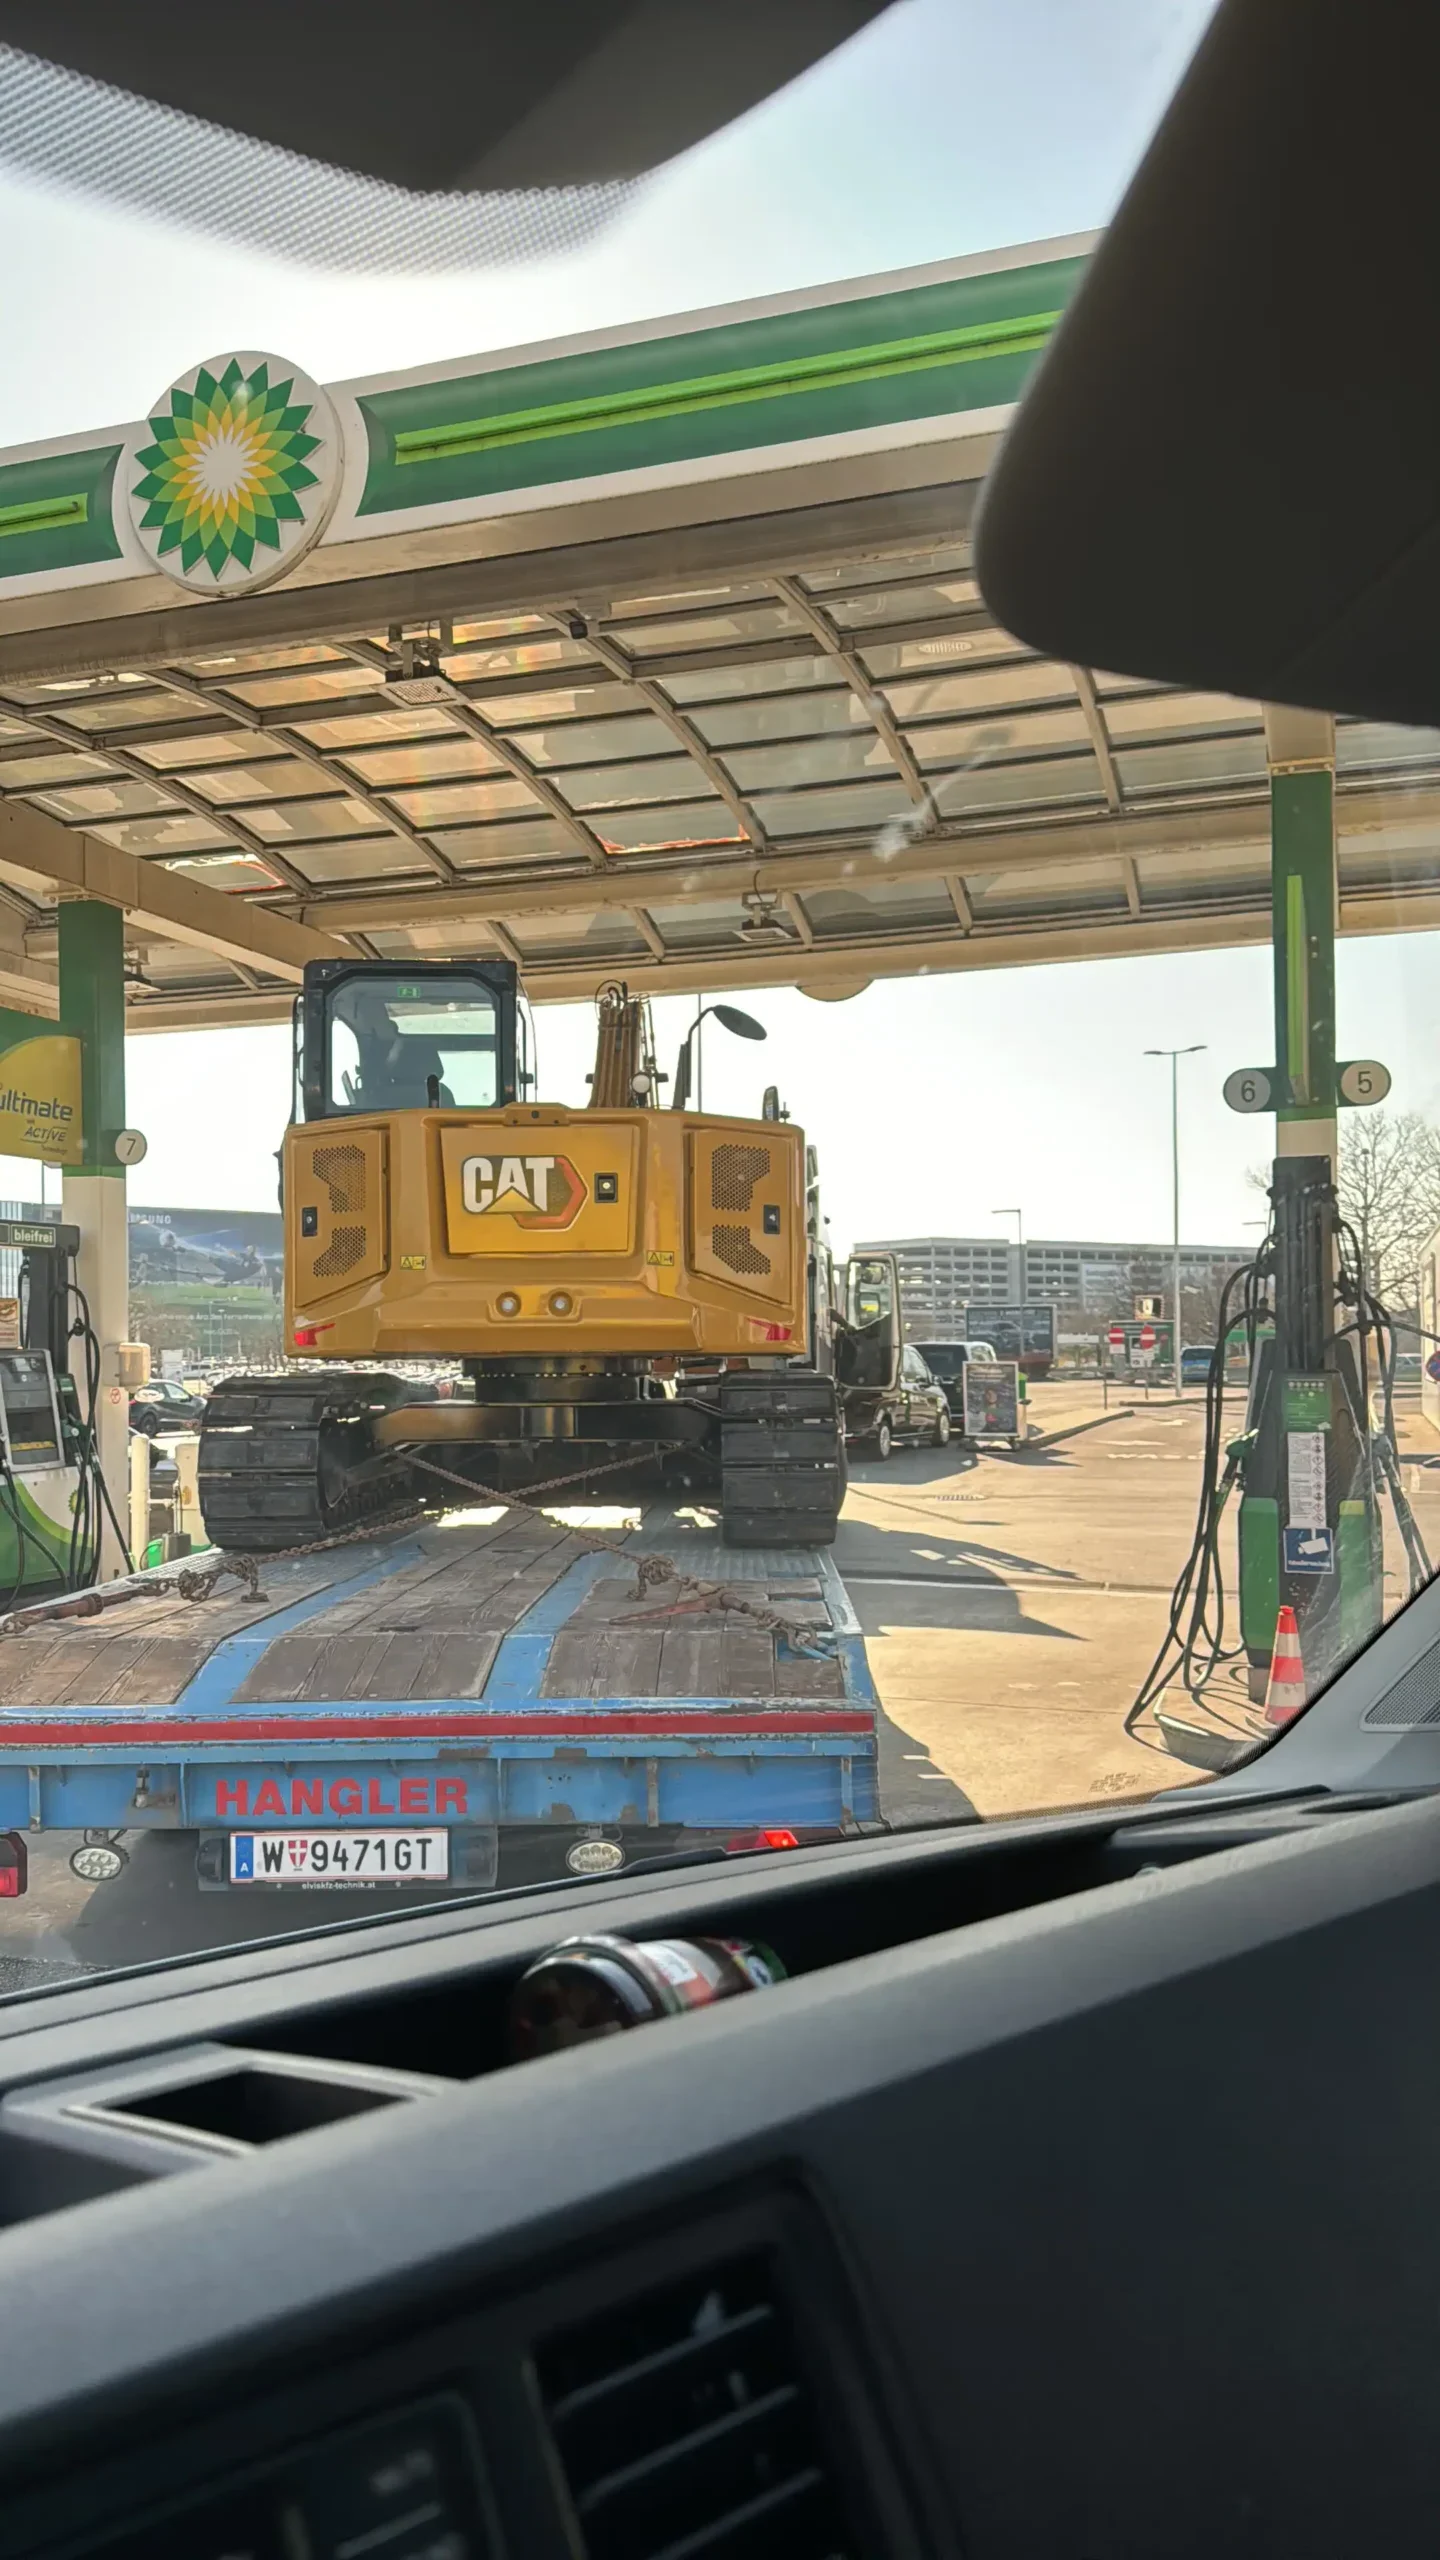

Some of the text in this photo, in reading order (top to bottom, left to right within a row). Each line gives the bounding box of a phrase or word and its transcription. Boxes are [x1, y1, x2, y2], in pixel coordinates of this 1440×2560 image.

[1240, 1080, 1256, 1103] 6
[1357, 1071, 1373, 1094] 5
[126, 1138, 136, 1156] 7
[463, 1157, 555, 1213] CAT
[13, 1228, 53, 1244] bleifrei
[215, 1777, 469, 1816] HANGLER
[240, 1862, 249, 1873] A
[262, 1840, 284, 1872] W
